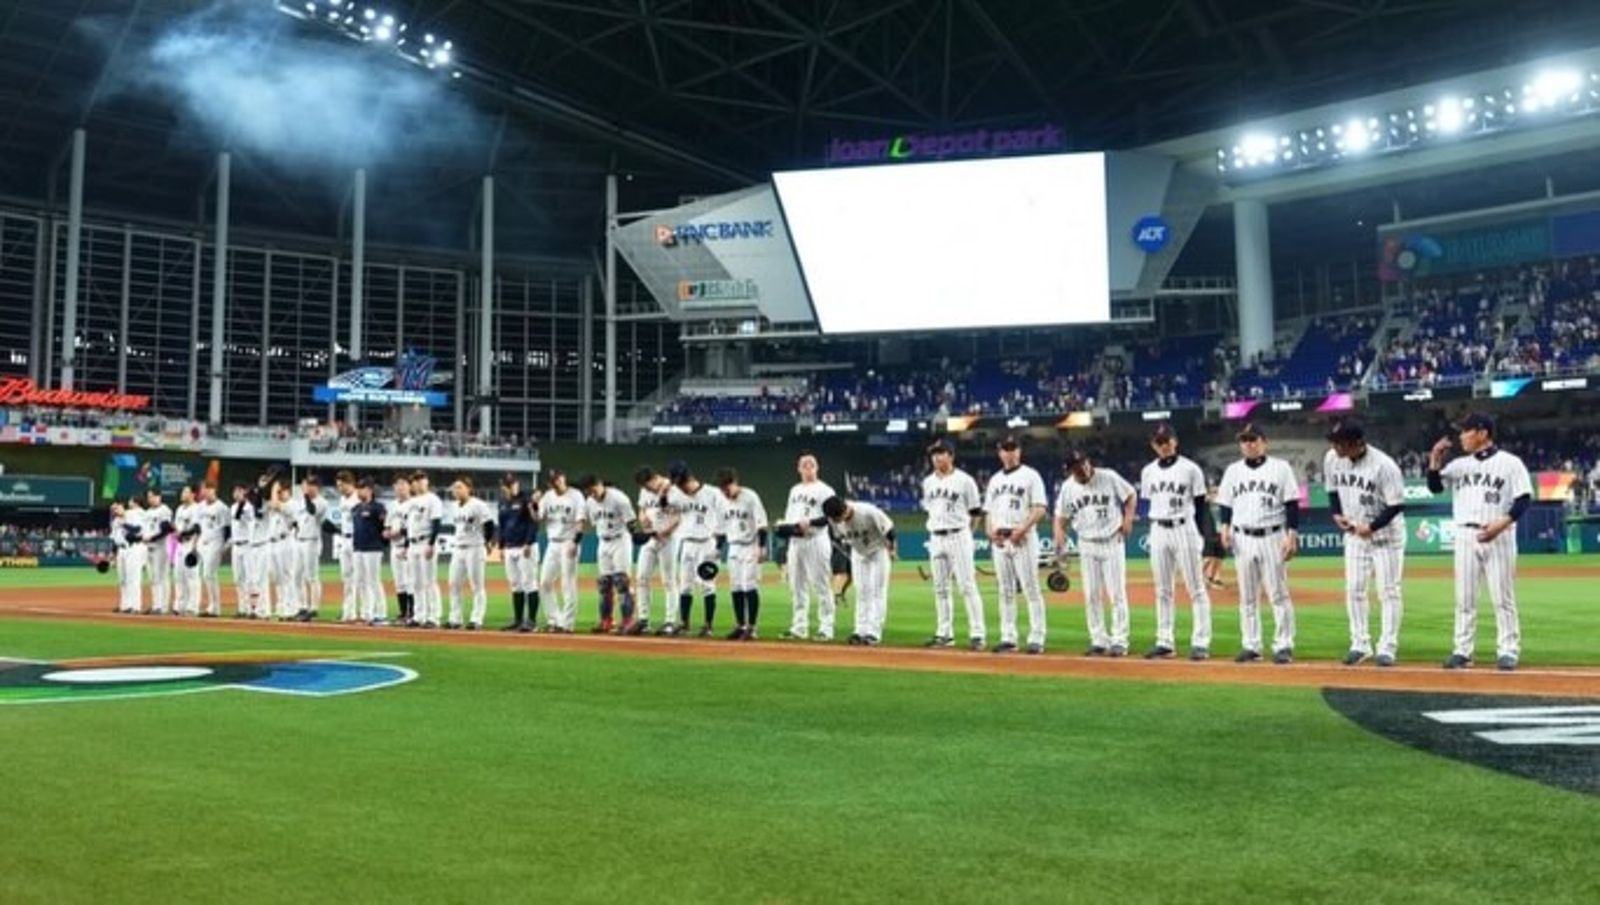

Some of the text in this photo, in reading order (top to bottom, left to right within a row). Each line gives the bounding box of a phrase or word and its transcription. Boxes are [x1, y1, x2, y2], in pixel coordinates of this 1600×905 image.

[992, 125, 1063, 154] park
[1232, 480, 1278, 498] JAPAN
[1333, 473, 1376, 494] JAPAN
